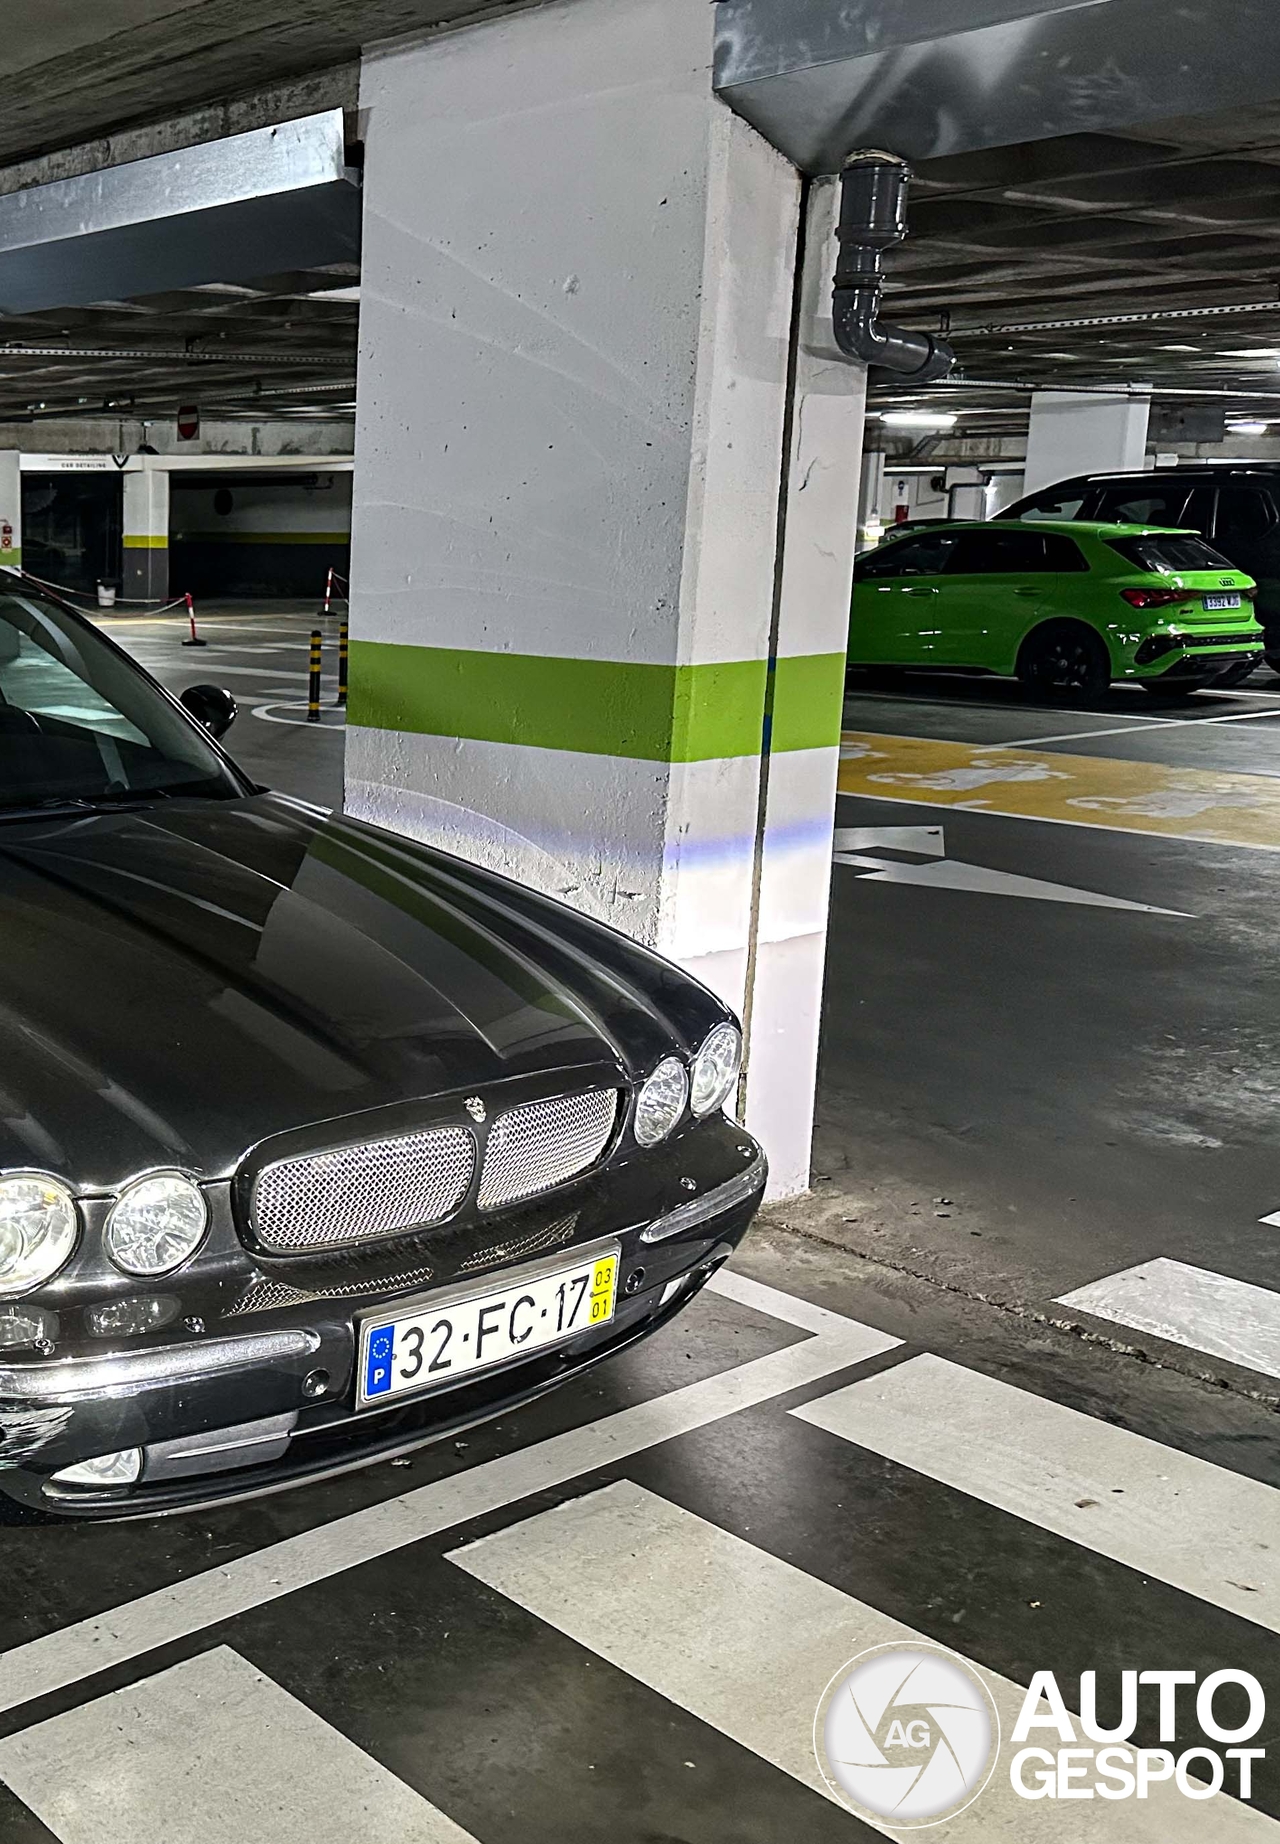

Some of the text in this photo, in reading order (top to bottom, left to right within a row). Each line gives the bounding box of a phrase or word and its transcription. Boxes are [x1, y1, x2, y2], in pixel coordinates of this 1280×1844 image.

[595, 1267, 612, 1287] 03
[592, 1300, 608, 1319] 01
[373, 1368, 385, 1385] P
